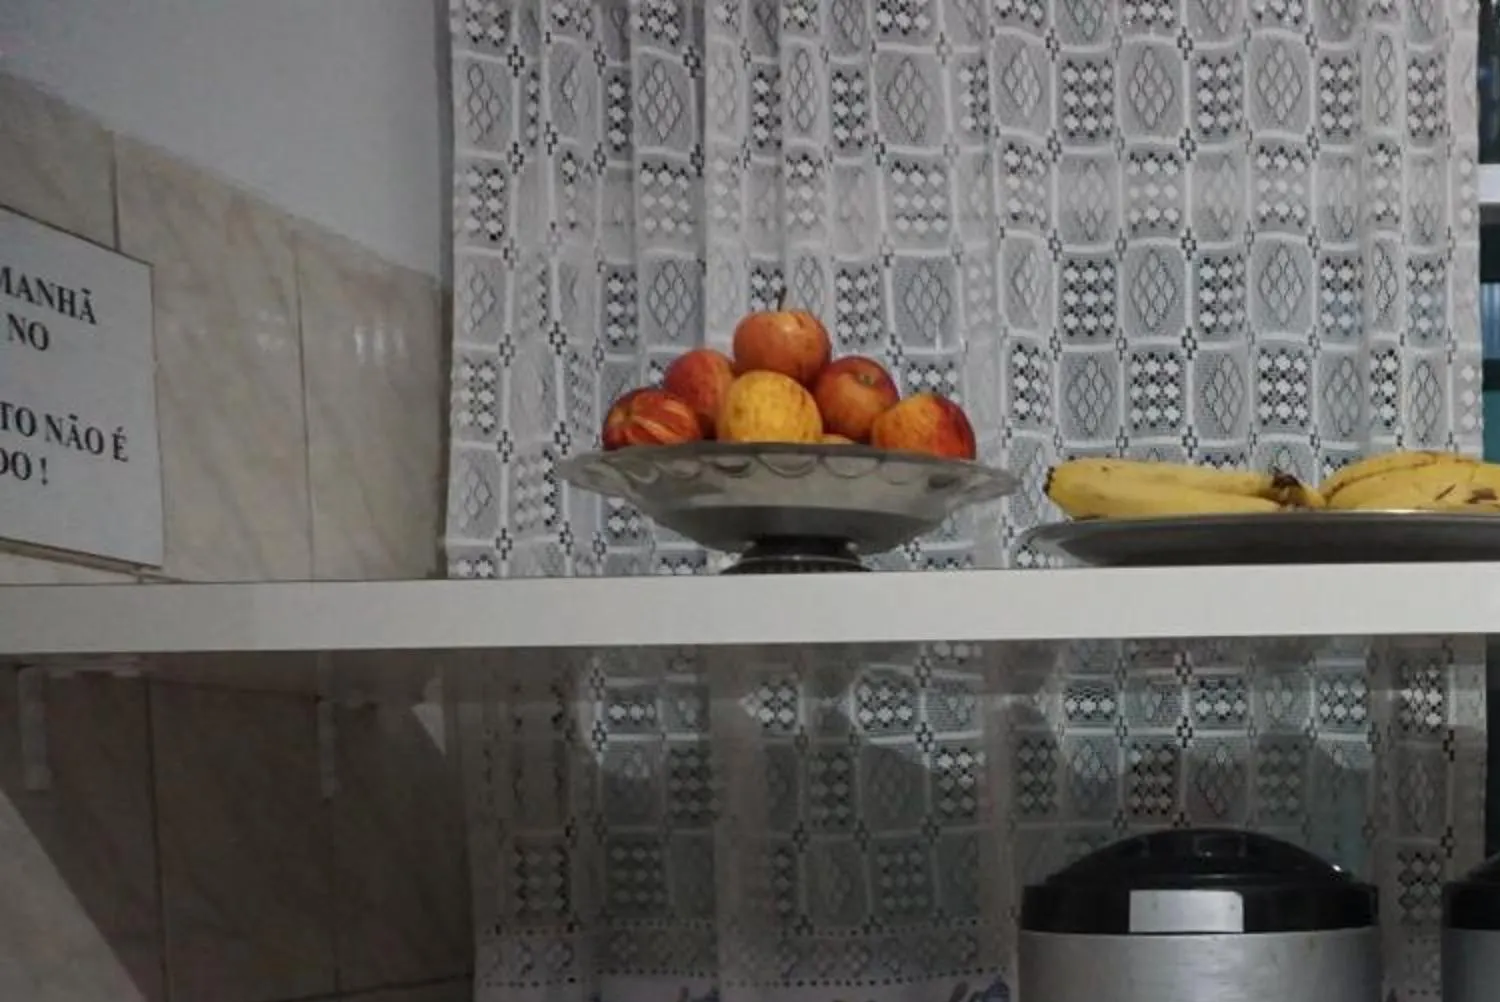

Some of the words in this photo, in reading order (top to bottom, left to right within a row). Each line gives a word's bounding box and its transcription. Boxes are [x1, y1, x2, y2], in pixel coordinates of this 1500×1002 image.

[7, 312, 50, 351] NO
[44, 413, 104, 456] NÃO
[112, 426, 128, 462] É
